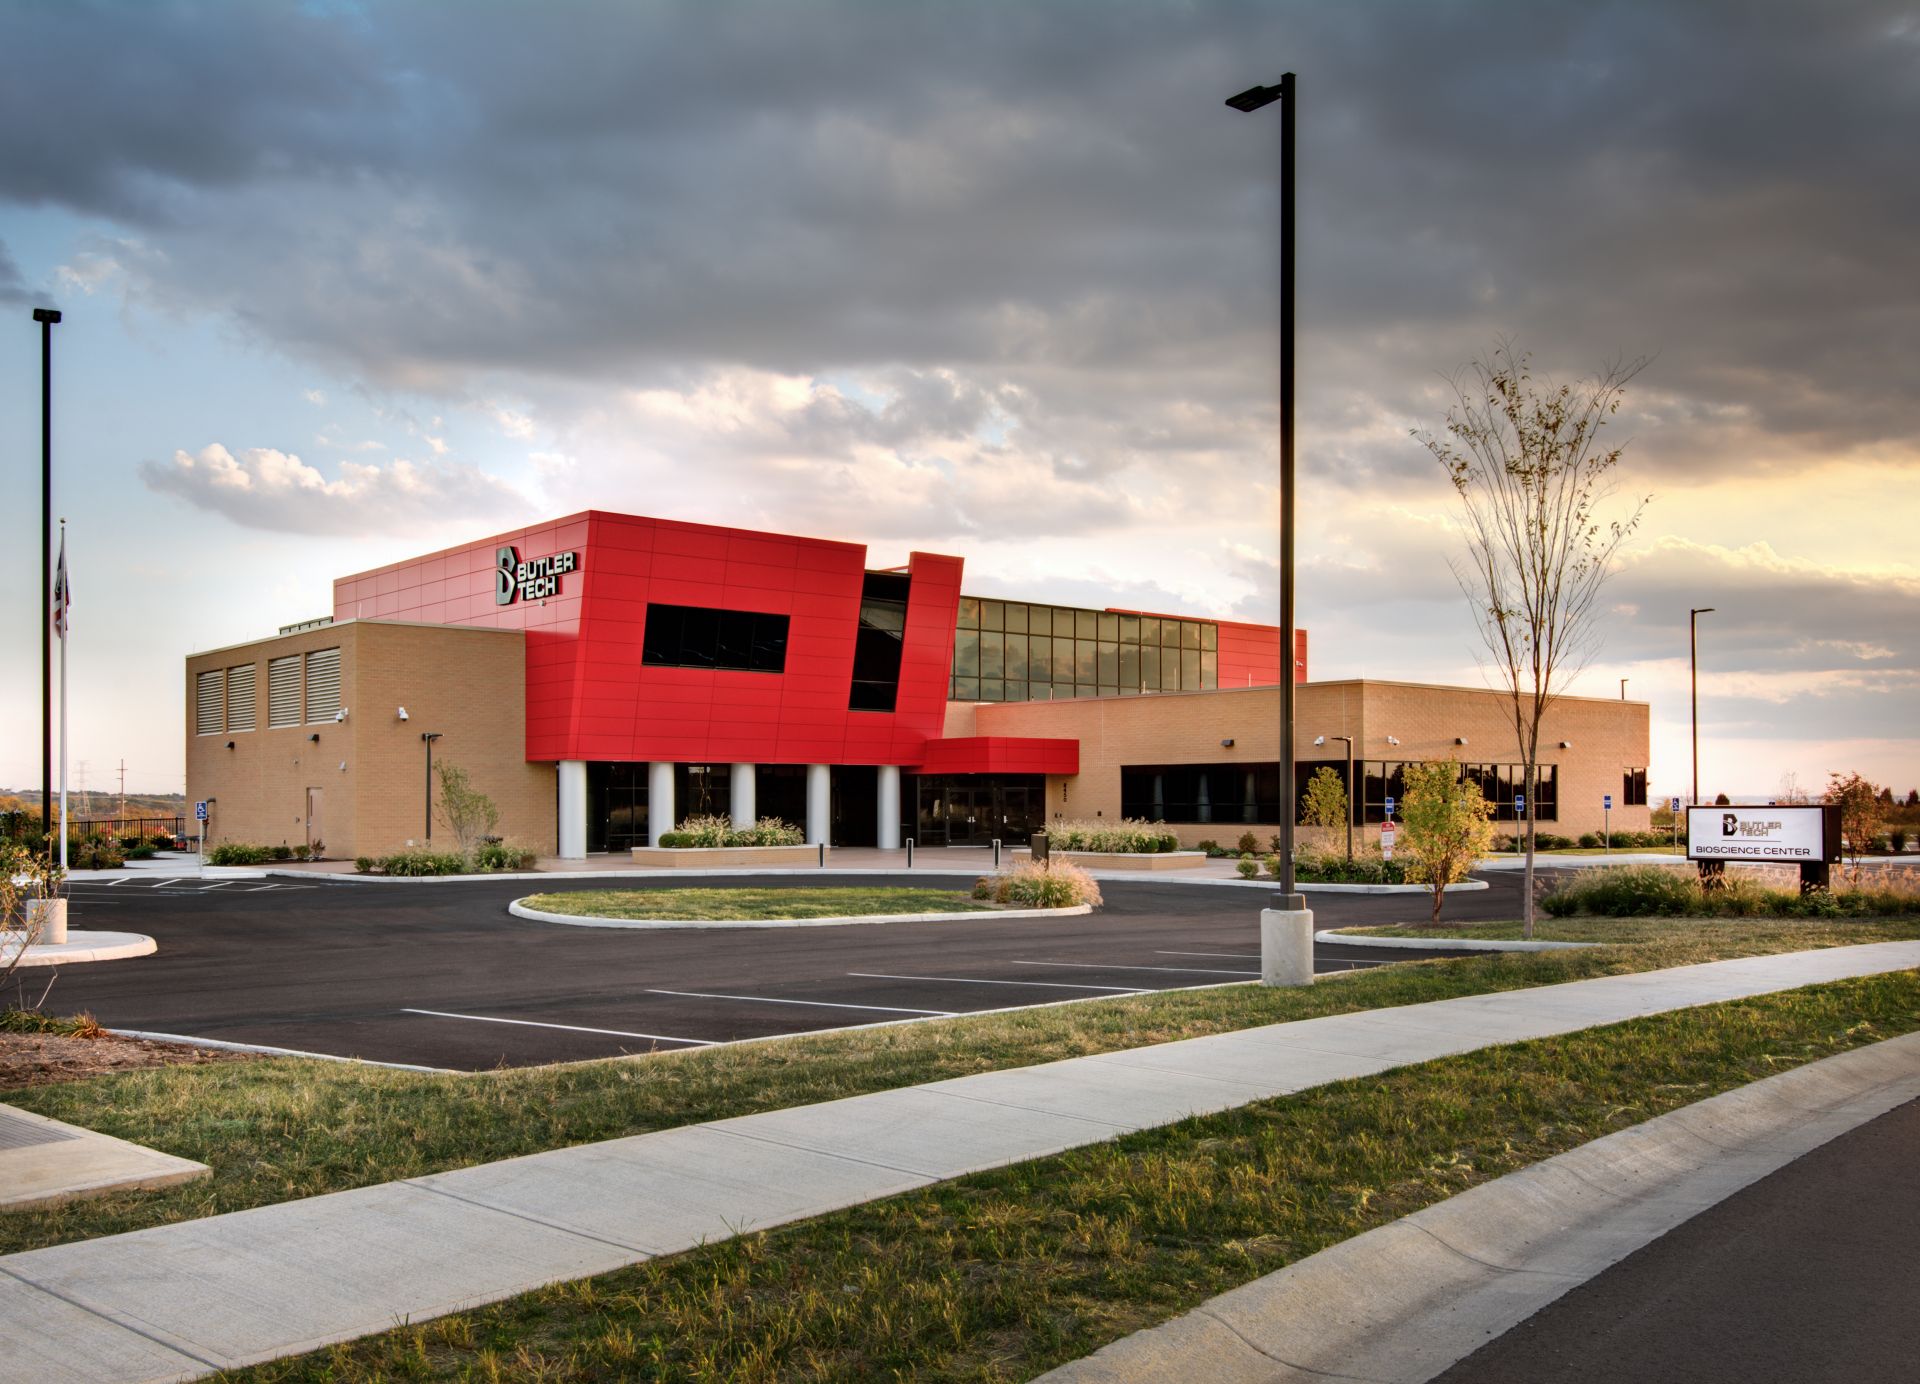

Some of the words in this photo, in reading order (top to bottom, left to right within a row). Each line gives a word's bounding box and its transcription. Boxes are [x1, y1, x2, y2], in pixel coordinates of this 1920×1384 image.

[517, 552, 575, 582] BUTLER
[517, 576, 557, 600] TECH
[1739, 821, 1782, 830] BUTLER
[1740, 828, 1769, 837] TECH
[1695, 845, 1761, 855] BIOSCIENCE
[1763, 847, 1811, 856] CENTER
